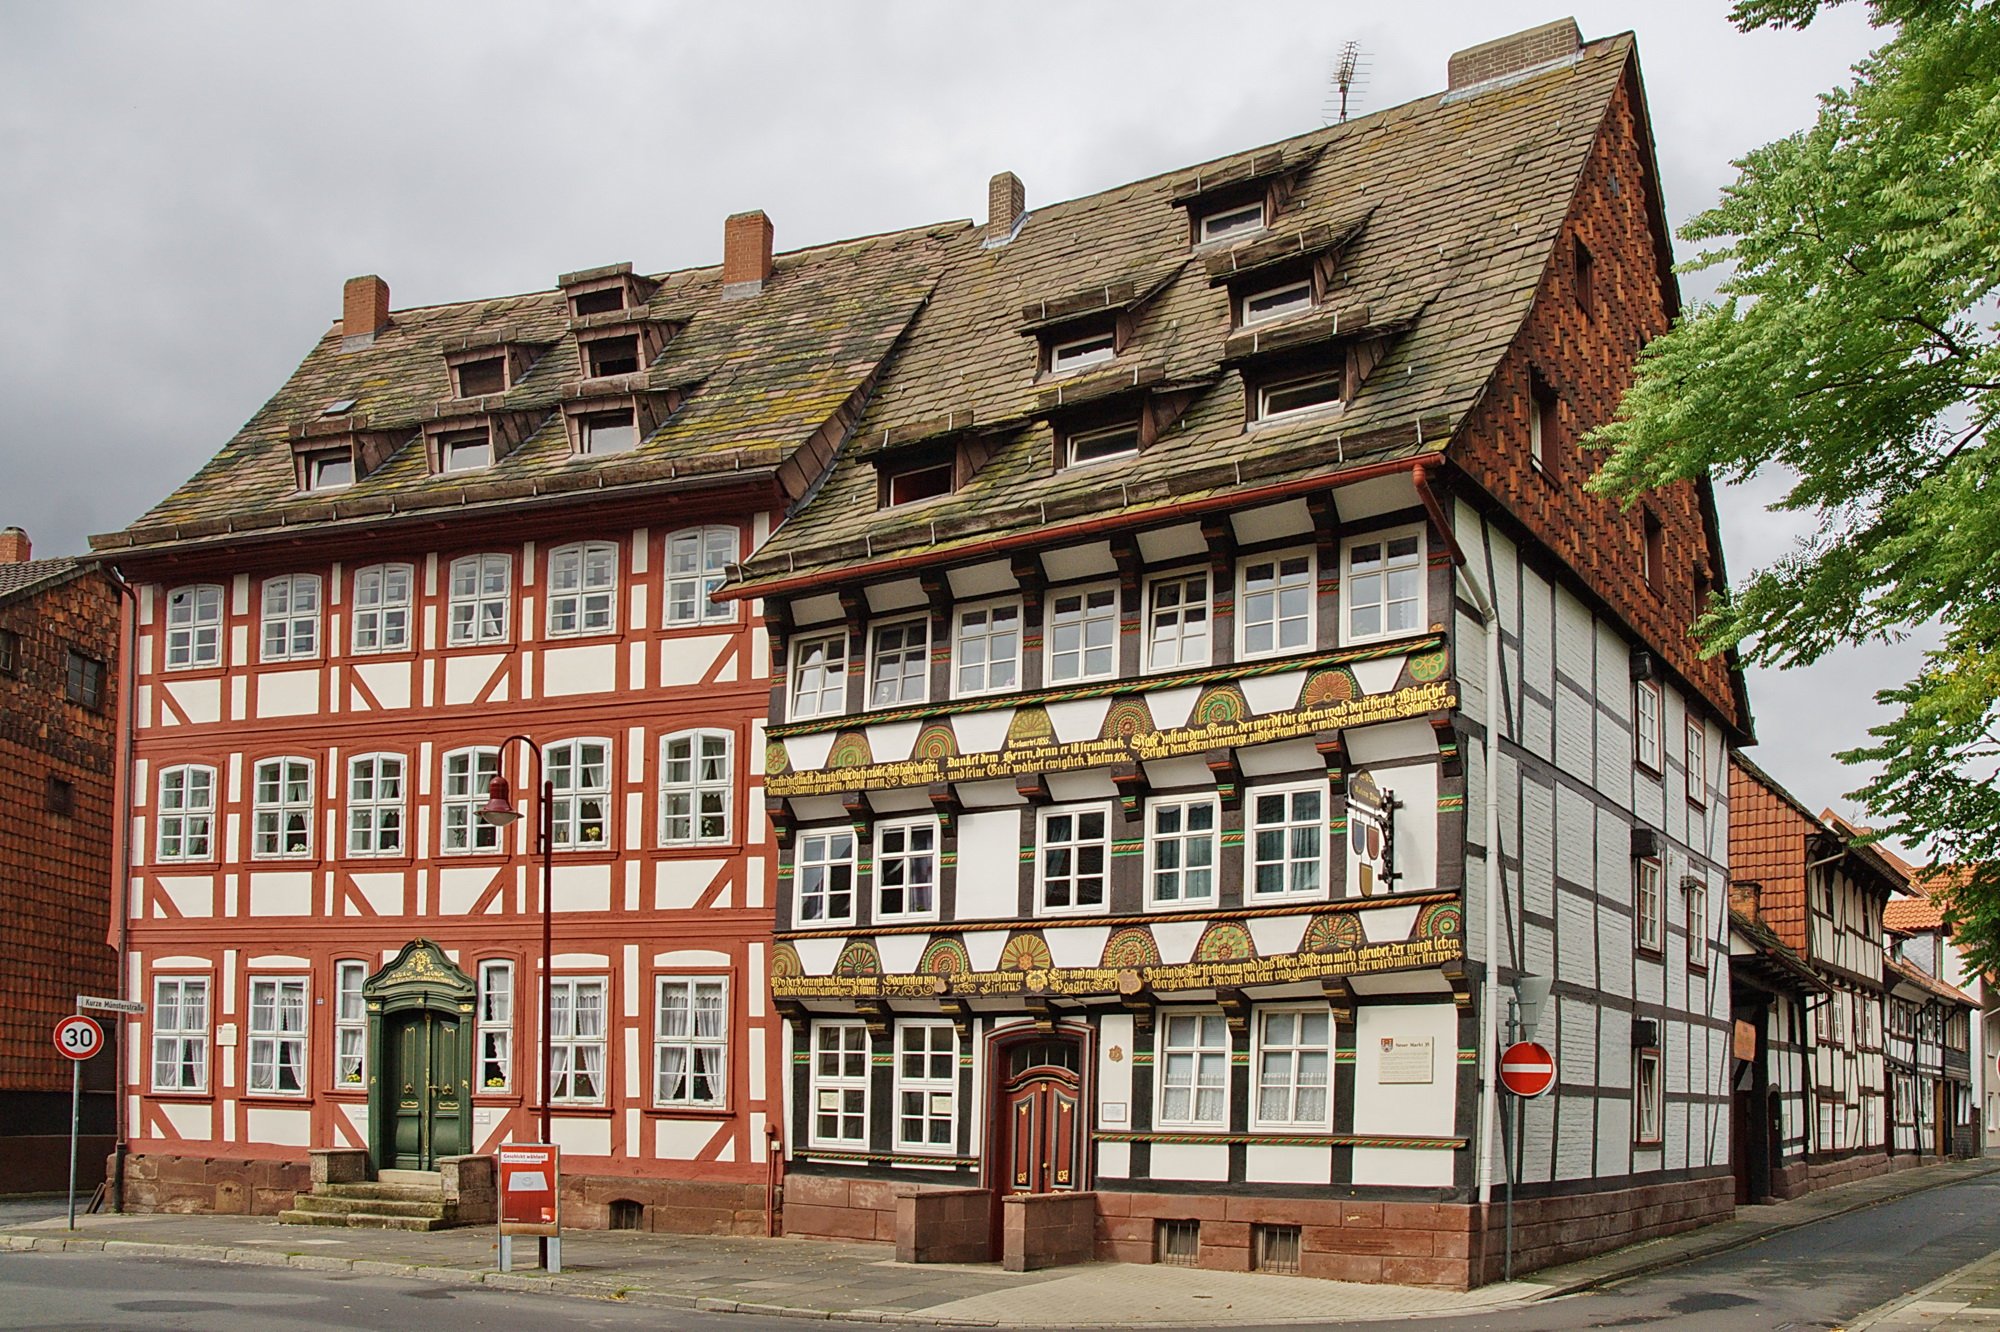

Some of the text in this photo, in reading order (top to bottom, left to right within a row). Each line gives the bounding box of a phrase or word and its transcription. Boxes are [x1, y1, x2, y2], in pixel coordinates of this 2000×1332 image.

[980, 752, 999, 764] dem
[104, 1001, 144, 1012] Münsterstraße
[65, 1028, 92, 1047] 30
